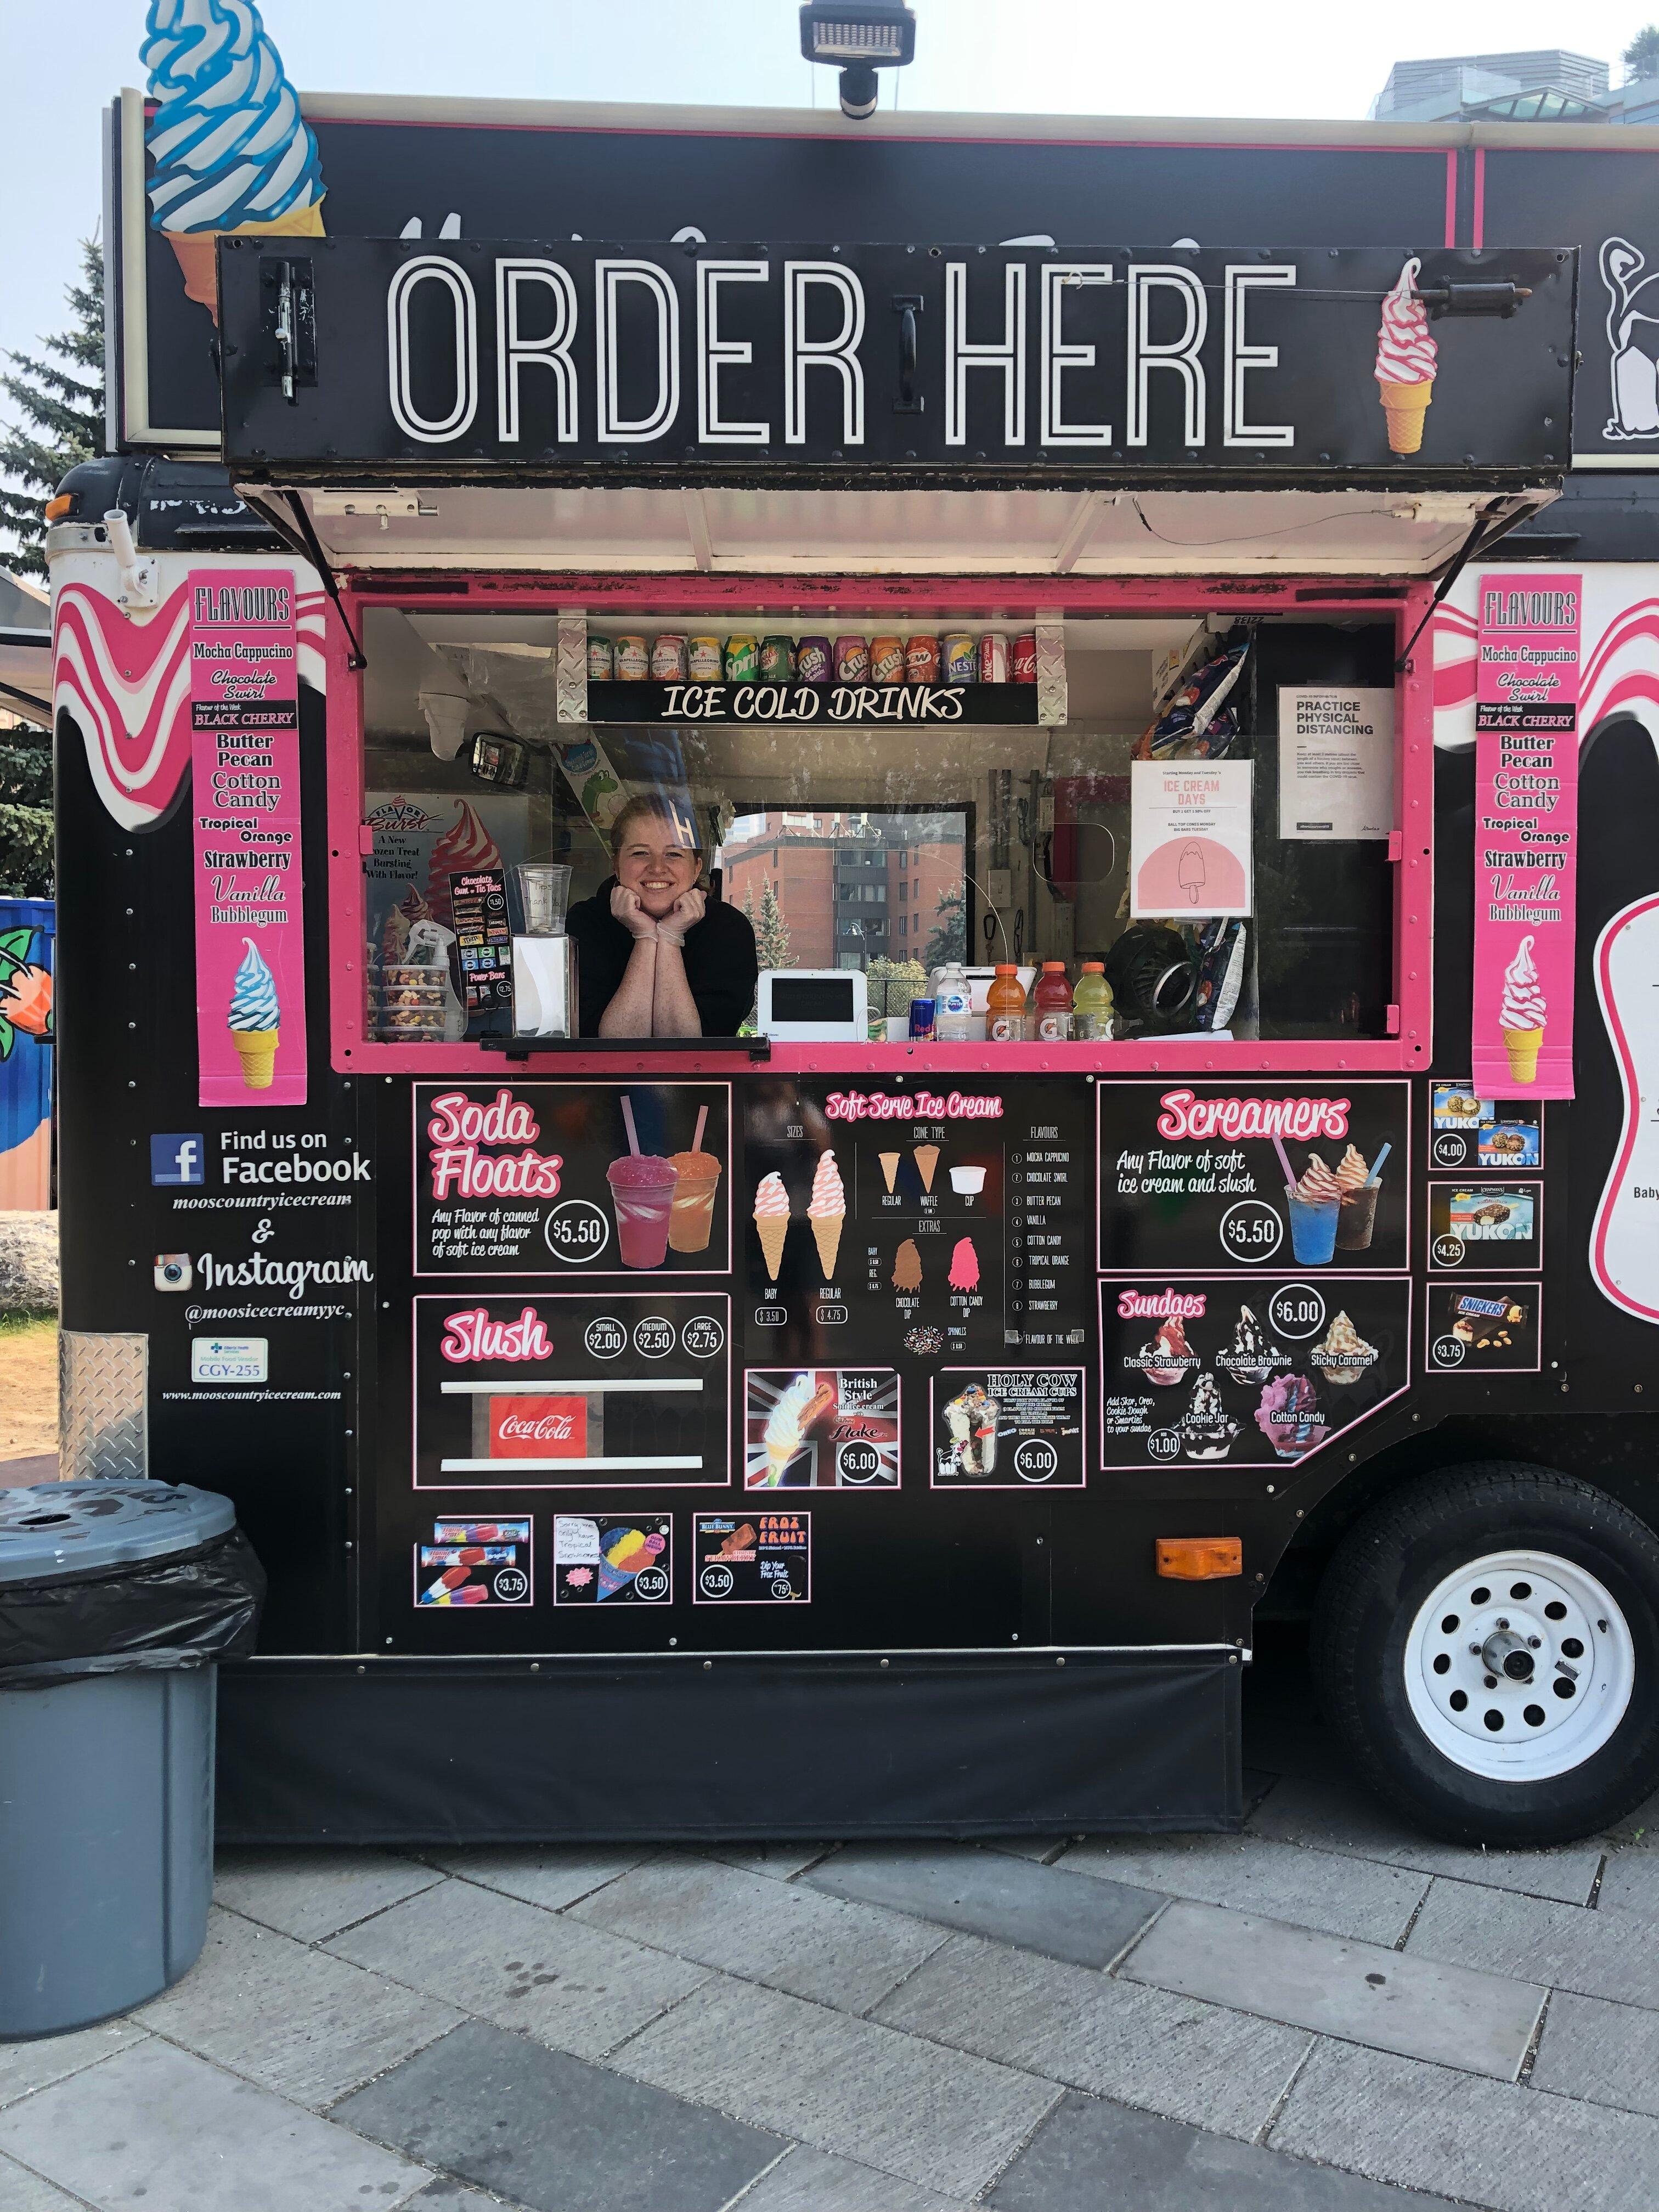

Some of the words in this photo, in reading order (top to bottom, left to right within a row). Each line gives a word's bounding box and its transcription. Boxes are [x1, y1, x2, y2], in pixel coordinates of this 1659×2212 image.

[387, 255, 865, 444] ORDER
[944, 263, 1296, 447] HERE
[195, 587, 289, 622] FLAVOURS
[1485, 592, 1576, 625] FLAVOURS
[194, 642, 230, 659] Mocha
[235, 643, 293, 662] Cappucino
[1482, 646, 1517, 662] Mocha
[1521, 646, 1577, 665] Cappucino
[211, 670, 276, 685] Chocolate
[1497, 673, 1560, 688] Chocolate
[223, 685, 265, 699] Swirl
[1509, 688, 1549, 702] Swirl
[661, 685, 727, 718] ICE
[733, 686, 820, 720] COLD
[827, 685, 966, 720] DRINKS
[1296, 701, 1361, 712] PRACTICE
[194, 713, 239, 725] BLACK
[241, 713, 295, 725] CHERRY
[1296, 713, 1359, 723] PHYSICAL
[1477, 715, 1521, 726] BLACK
[1522, 715, 1574, 727] CHERRY
[1296, 724, 1374, 735] DISTANCING
[216, 733, 274, 749] Butter
[1500, 735, 1555, 751] Butter
[218, 752, 273, 767] Pecan
[1501, 753, 1553, 768] Pecan
[212, 772, 281, 789] Cotton
[1164, 780, 1180, 792] ICE
[1183, 780, 1220, 792] CREAM
[1493, 772, 1560, 790] Cotton
[213, 791, 280, 811] Candy
[1178, 793, 1205, 805] DAYS
[1494, 791, 1559, 812] Candy
[375, 805, 421, 821] FLAVOR
[199, 817, 258, 831] Tropical
[365, 814, 443, 832] Burst
[1482, 817, 1538, 832] Tropical
[240, 830, 292, 845] Orange
[379, 835, 386, 844] A
[388, 836, 407, 844] New
[1520, 832, 1570, 845] Orange
[204, 850, 291, 869] Strawberry
[374, 858, 412, 870] Bursting
[1485, 850, 1566, 870] Strawberry
[211, 874, 286, 902] Vanilla
[461, 875, 493, 886] Chocolate
[531, 881, 552, 893] Tips
[1490, 874, 1560, 901] Vanilla
[211, 906, 287, 928] Bubblegum
[1489, 904, 1561, 926] Bubblegum
[914, 1024, 931, 1033] Red
[992, 1019, 1010, 1041] G
[1039, 1018, 1058, 1039] G
[826, 1093, 866, 1121] Soft
[868, 1093, 913, 1119] Serve
[915, 1092, 945, 1118] Ice
[947, 1092, 1002, 1118] Cream
[431, 1092, 537, 1143] Soda
[1160, 1092, 1349, 1138] Screamers
[787, 1125, 804, 1138] SIZES
[913, 1126, 928, 1139] CONE
[931, 1126, 945, 1139] TYPE
[1030, 1126, 1058, 1139] FLAVOURS
[221, 1130, 266, 1150] Find
[272, 1134, 296, 1149] us
[301, 1133, 327, 1148] on
[1438, 1143, 1463, 1156] $4.00
[1116, 1149, 1143, 1174] Any
[1148, 1149, 1193, 1171] Flavor
[1196, 1149, 1212, 1172] of
[1214, 1149, 1246, 1172] soft
[1479, 1153, 1539, 1166] YUKON
[222, 1152, 372, 1184] Facebook
[432, 1146, 560, 1197] Floats
[1118, 1173, 1138, 1194] ice
[1141, 1177, 1187, 1194] cream
[1188, 1172, 1216, 1193] and
[1218, 1172, 1257, 1193] slush
[172, 1192, 352, 1211] mooscountryicecream
[882, 1195, 901, 1206] REGULAR
[919, 1195, 938, 1206] WAFFLE
[965, 1195, 975, 1206] CUP
[432, 1209, 452, 1225] Any
[454, 1209, 488, 1224] Flavor
[488, 1207, 501, 1226] of
[503, 1207, 540, 1224] canned
[1026, 1215, 1046, 1226] VANILLA
[251, 1218, 275, 1244] &
[432, 1227, 451, 1243] pop
[453, 1223, 478, 1240] with
[479, 1227, 498, 1243] any
[554, 1219, 600, 1244] $5.50
[918, 1220, 941, 1233] EXTRAS
[1228, 1219, 1274, 1244] $5.50
[1451, 1222, 1533, 1240] YUKON
[432, 1242, 444, 1259] of
[446, 1242, 469, 1258] soft
[470, 1243, 486, 1256] ice
[487, 1243, 520, 1256] cream
[1437, 1244, 1461, 1257] $4.25
[197, 1251, 374, 1300] Instagram
[764, 1288, 777, 1300] BABY
[820, 1288, 841, 1299] REGULAR
[895, 1297, 920, 1308] CHOCOLATE
[1119, 1289, 1205, 1317] Sundaes
[1459, 1297, 1506, 1316] SNICKERS
[185, 1303, 346, 1324] @moosicecreamyyc
[1276, 1301, 1318, 1322] $6.00
[596, 1322, 616, 1333] SMALL
[641, 1322, 667, 1332] MEDIUM
[693, 1321, 712, 1331] LARGE
[443, 1310, 550, 1360] Slush
[589, 1332, 621, 1350] $2.00
[638, 1332, 670, 1350] $2.50
[687, 1331, 718, 1349] $2.75
[1025, 1334, 1046, 1344] FLAVOUR
[1047, 1334, 1053, 1344] OF
[1055, 1334, 1064, 1344] THE
[1437, 1345, 1460, 1357] $3.75
[1124, 1357, 1153, 1368] Classic
[1154, 1356, 1201, 1369] Strawberry
[1215, 1355, 1256, 1367] Chocolate
[1258, 1355, 1293, 1367] Brownie
[1311, 1355, 1337, 1368] Sticky
[1338, 1355, 1373, 1366] Caramel
[199, 1364, 260, 1376] CGY-255
[839, 1378, 878, 1389] British
[987, 1374, 1035, 1387] HOLY
[1036, 1373, 1078, 1387] COW
[162, 1389, 341, 1402] www.mooscountryicecream.com
[844, 1390, 873, 1403] Style
[987, 1387, 1007, 1397] ICE
[1008, 1387, 1048, 1397] CREAM
[1048, 1387, 1077, 1397] CUPS
[1186, 1413, 1214, 1424] Cookie
[1215, 1413, 1229, 1423] Jar
[1271, 1412, 1297, 1423] Cotton
[1299, 1412, 1325, 1424] Candy
[498, 1414, 577, 1441] Coca-Cola
[1150, 1438, 1177, 1453] $1.00
[843, 1453, 876, 1470] $6.00
[1019, 1452, 1052, 1469] $6.00
[759, 1516, 799, 1530] FROZ
[759, 1531, 806, 1544] FRUIT
[499, 1578, 523, 1592] $3.75
[639, 1576, 664, 1590] $3.50
[705, 1575, 730, 1588] $3.50
